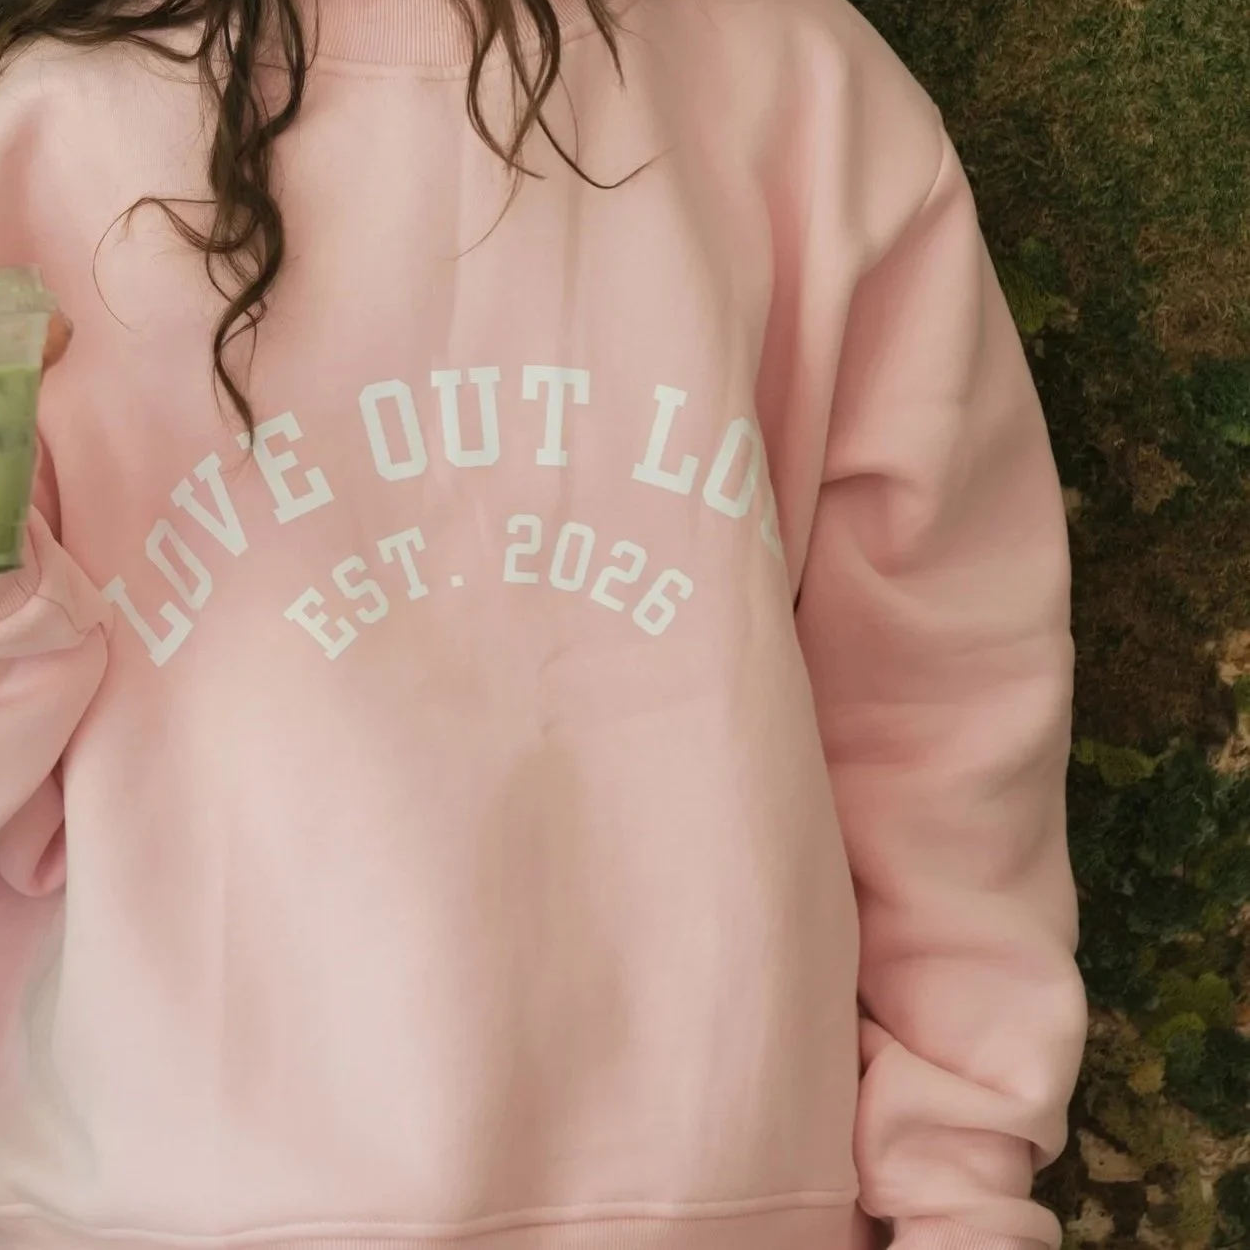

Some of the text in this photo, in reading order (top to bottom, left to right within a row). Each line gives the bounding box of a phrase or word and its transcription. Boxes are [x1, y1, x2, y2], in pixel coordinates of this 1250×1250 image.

[100, 362, 784, 668] LOVE OUT LO
[282, 513, 695, 662] EST. 2026
